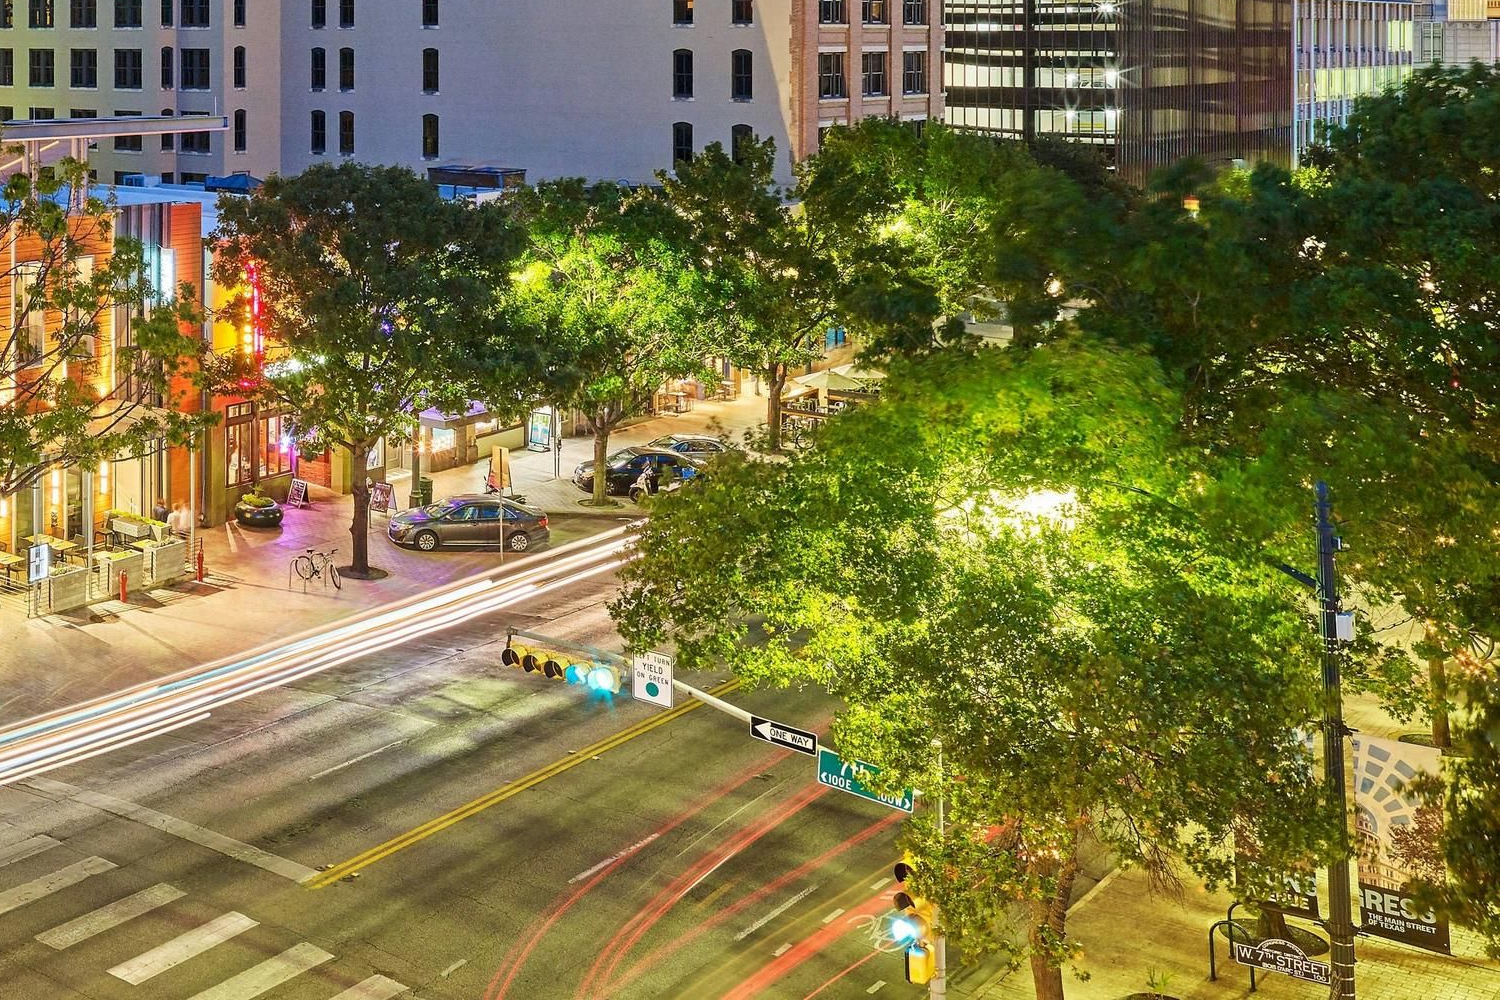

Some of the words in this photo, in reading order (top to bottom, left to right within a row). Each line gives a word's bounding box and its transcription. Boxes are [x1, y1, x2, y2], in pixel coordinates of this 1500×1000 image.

[642, 662, 663, 675] YIELD
[654, 656, 670, 666] TURN
[636, 670, 645, 678] ON
[649, 674, 669, 685] GREEN
[769, 728, 788, 741] ONE
[791, 734, 810, 748] WAY
[828, 773, 852, 790] 100E
[1367, 912, 1383, 922] THE
[1384, 916, 1405, 927] MAIN
[1406, 921, 1437, 935] STREET
[1368, 918, 1378, 926] OF
[1380, 921, 1405, 933] TEXAS
[1239, 946, 1254, 960] W.
[1256, 950, 1274, 961] 7TH
[1276, 955, 1328, 977] STREET
[1313, 974, 1327, 982] 100
